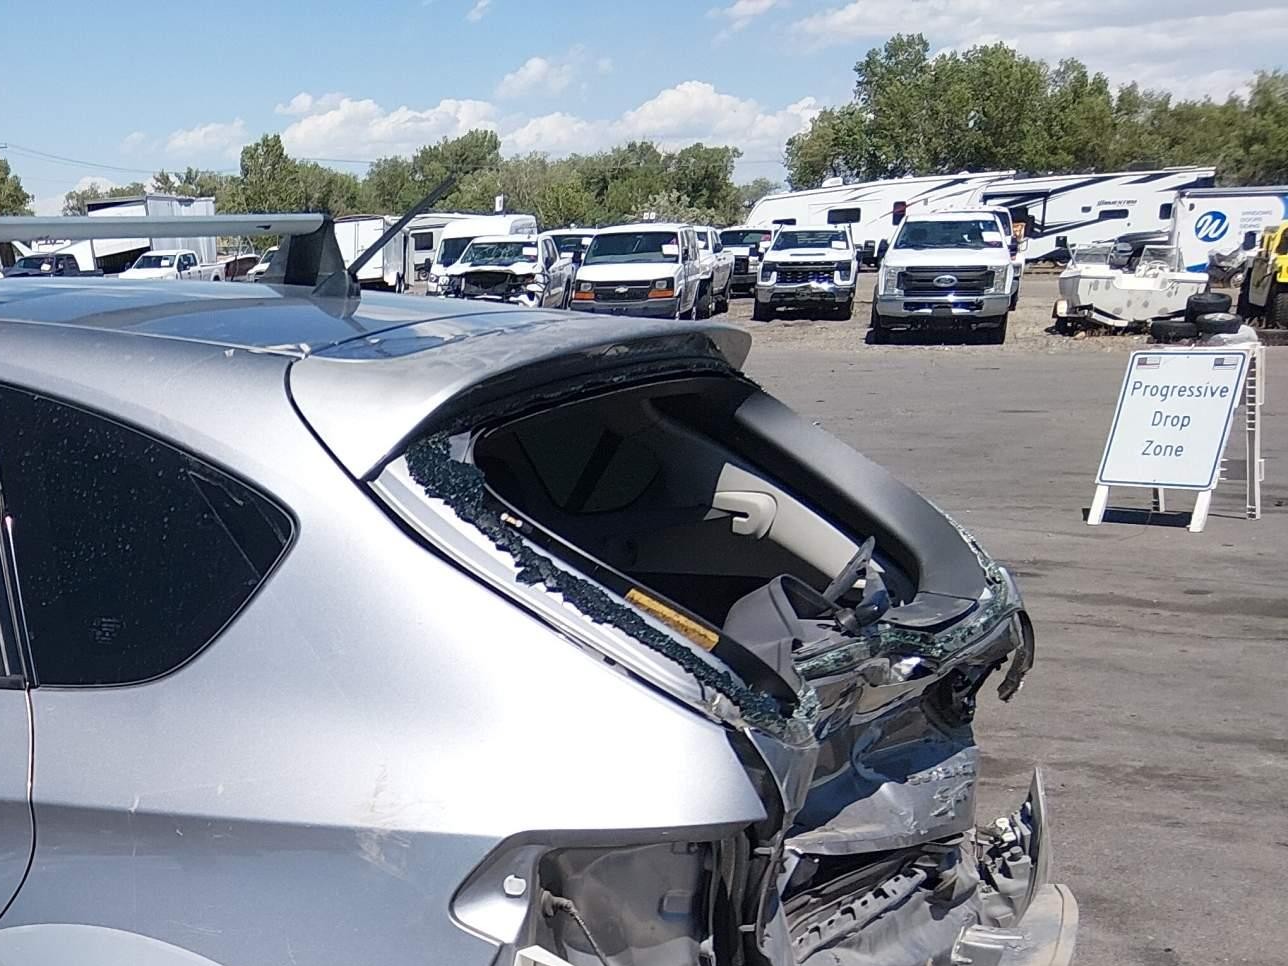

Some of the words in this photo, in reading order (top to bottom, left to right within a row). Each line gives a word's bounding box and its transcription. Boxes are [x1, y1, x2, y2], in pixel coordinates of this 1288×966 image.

[1130, 381, 1230, 402] Progressive
[1151, 410, 1191, 431] Drop
[1141, 440, 1184, 457] Zone
